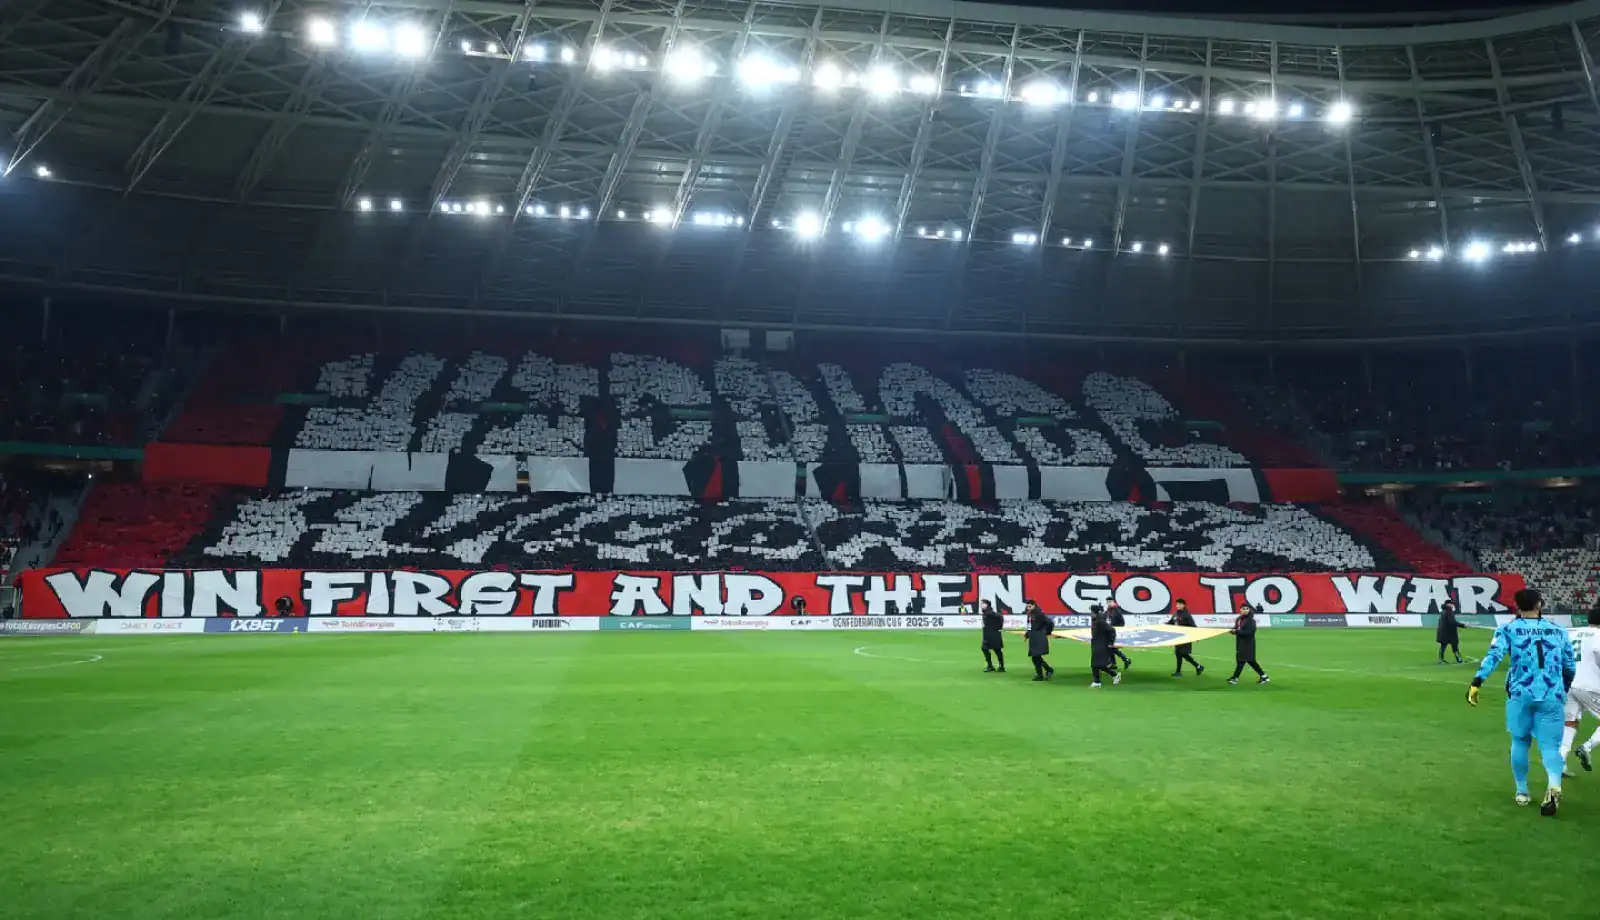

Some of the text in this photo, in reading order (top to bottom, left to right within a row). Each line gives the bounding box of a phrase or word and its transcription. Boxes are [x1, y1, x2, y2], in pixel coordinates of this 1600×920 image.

[46, 570, 1508, 617] WIN FIRST AND THEN GO TO WAR
[905, 617, 944, 627] 2025-26
[1535, 640, 1545, 669] 1
